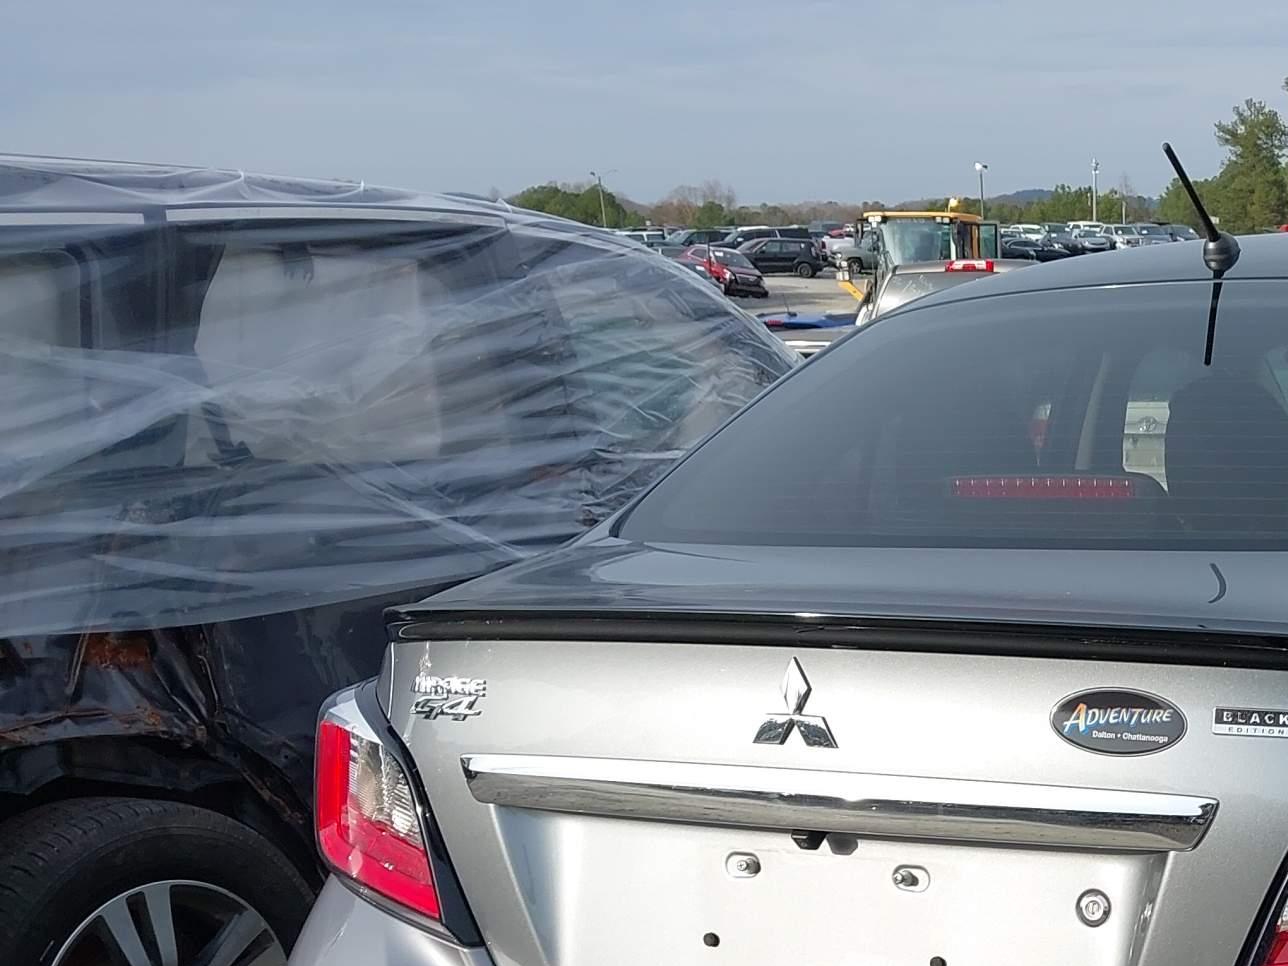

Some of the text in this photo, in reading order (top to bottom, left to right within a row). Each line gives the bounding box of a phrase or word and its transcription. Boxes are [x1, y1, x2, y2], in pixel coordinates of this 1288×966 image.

[409, 694, 482, 721] G4
[1063, 703, 1174, 733] ADVENTURE
[1223, 711, 1288, 725] BLACK
[1092, 730, 1169, 743] Dalton Chattanooga
[1228, 727, 1285, 735] EDITION
